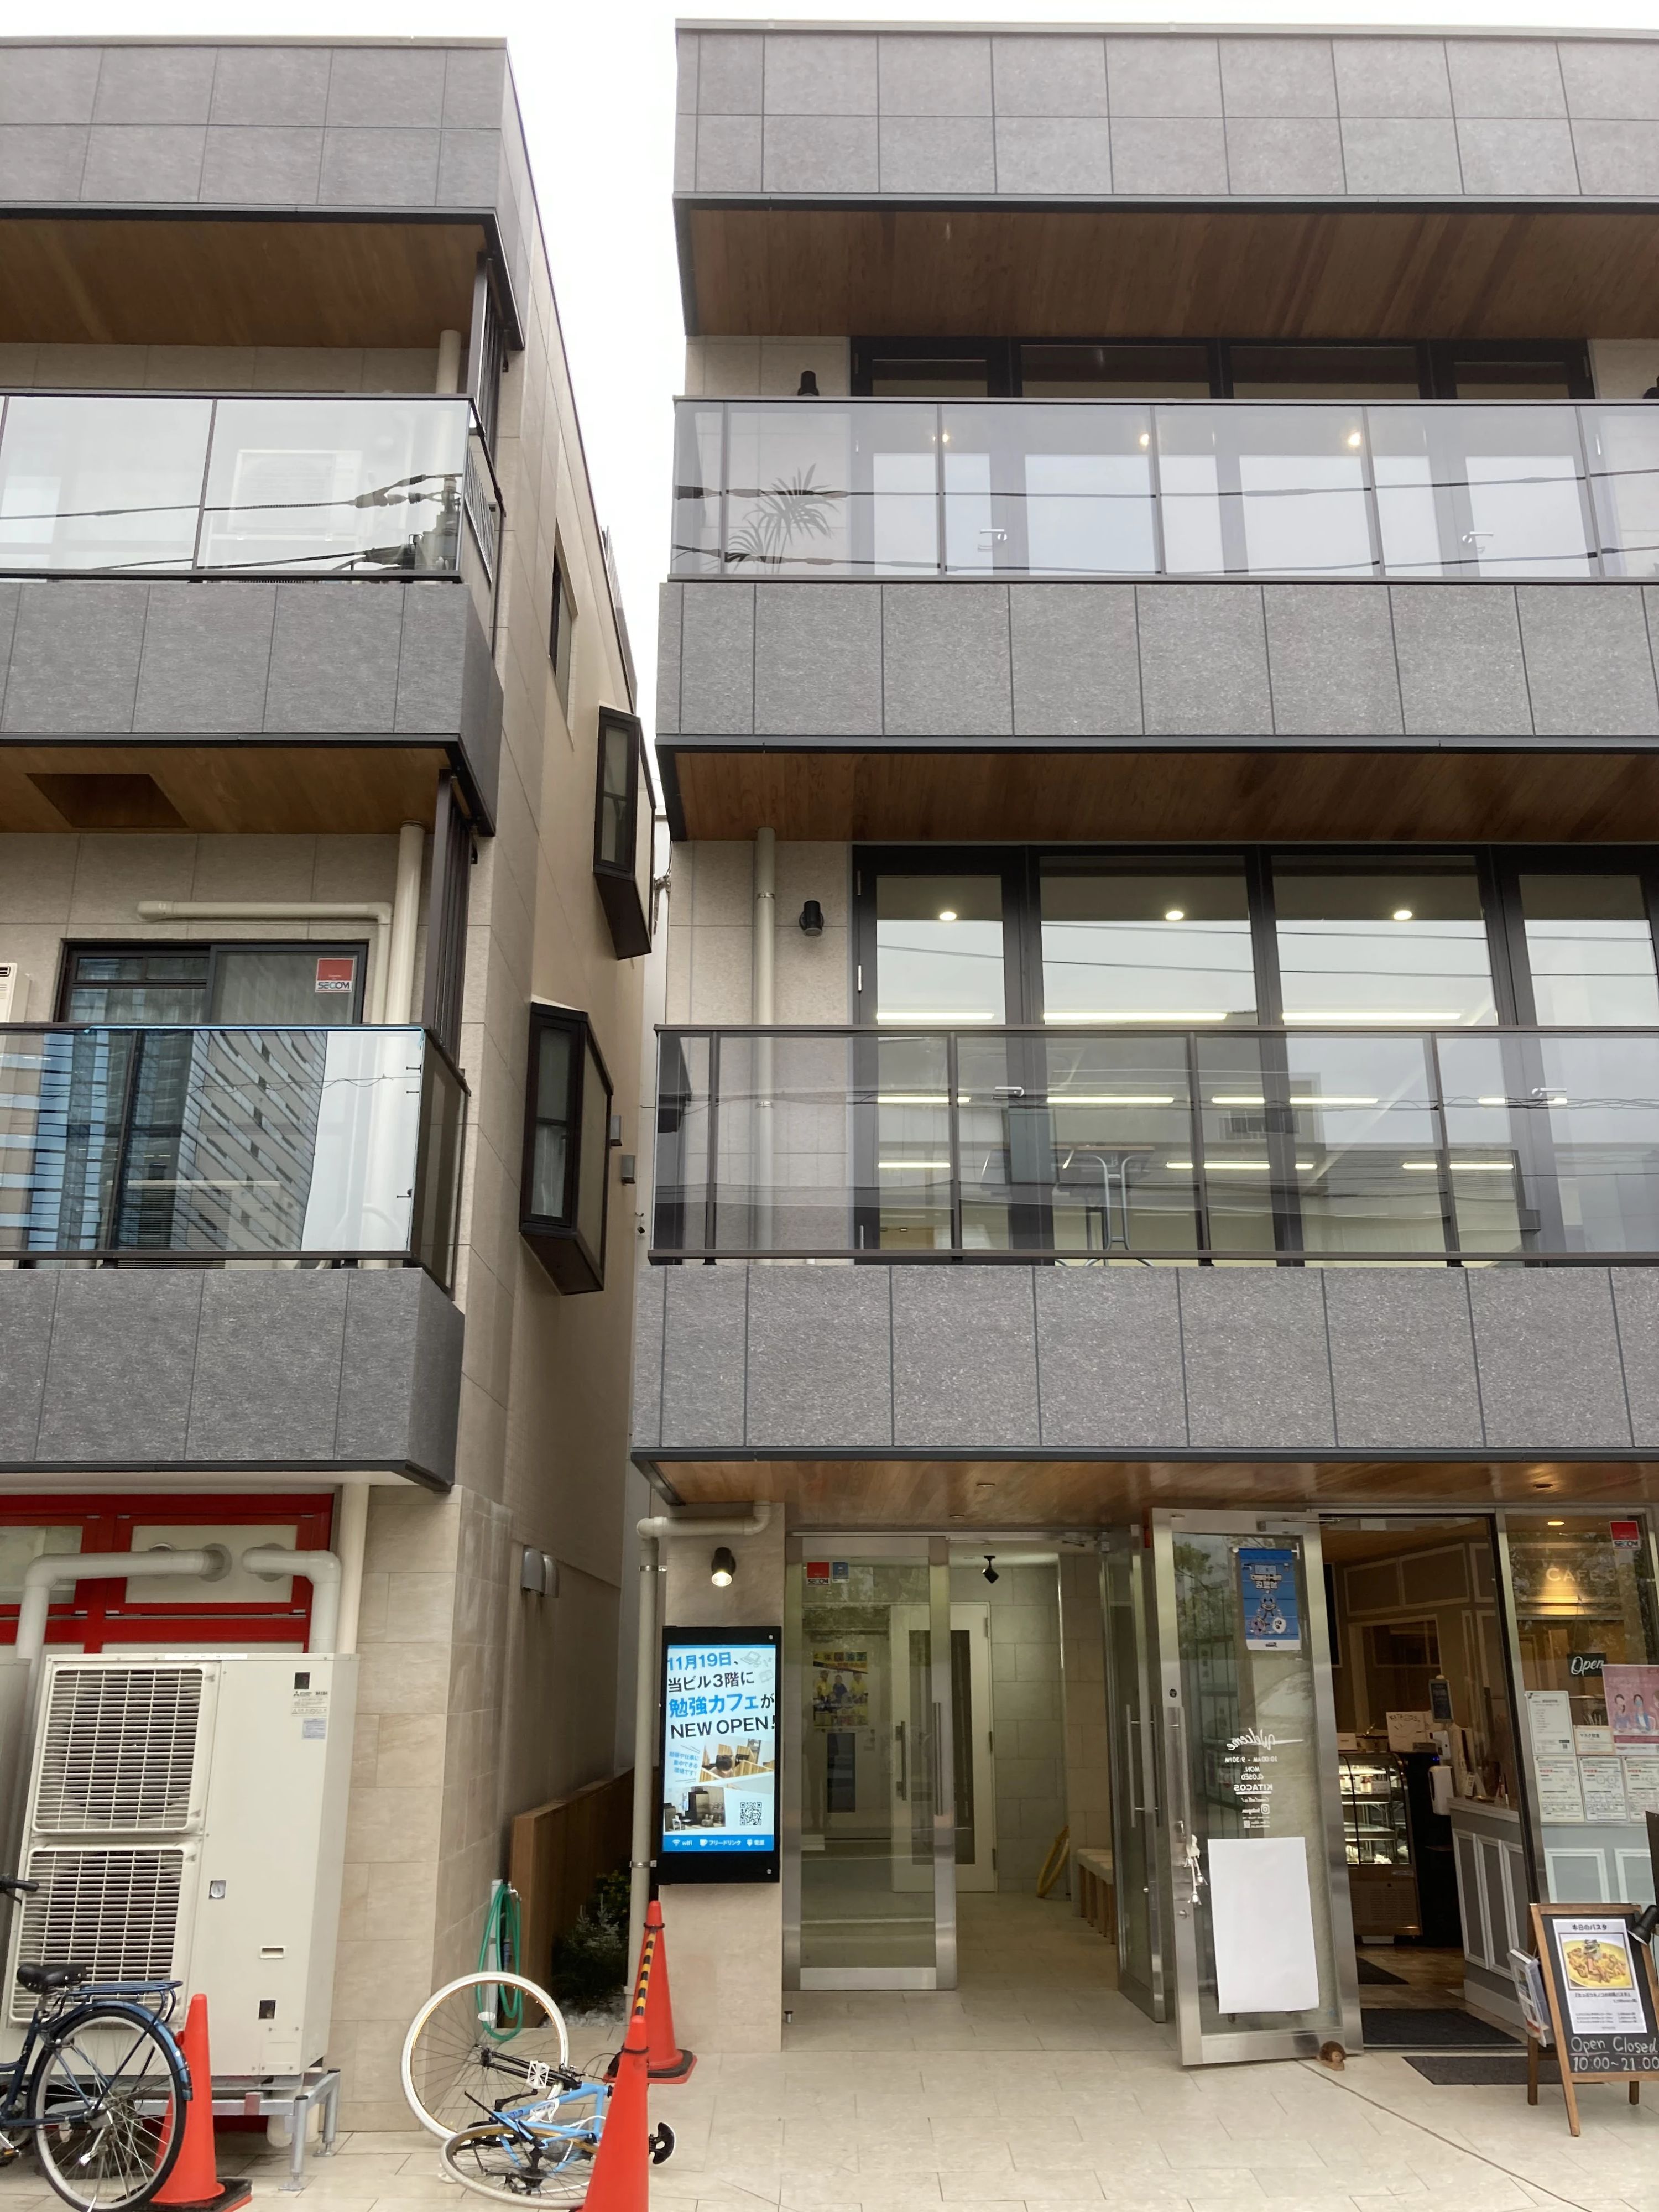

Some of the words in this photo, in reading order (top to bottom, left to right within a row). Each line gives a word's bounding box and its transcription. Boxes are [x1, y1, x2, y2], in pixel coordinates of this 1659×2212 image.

[667, 1652, 739, 1671] 11月19日、
[1571, 1656, 1604, 1676] Open
[668, 1672, 754, 1693] 当ビル3階に
[669, 1693, 774, 1718] 勉強カフェが
[671, 1721, 712, 1739] NEW
[1571, 2036, 1606, 2057] Open
[1613, 2036, 1658, 2053] Closed
